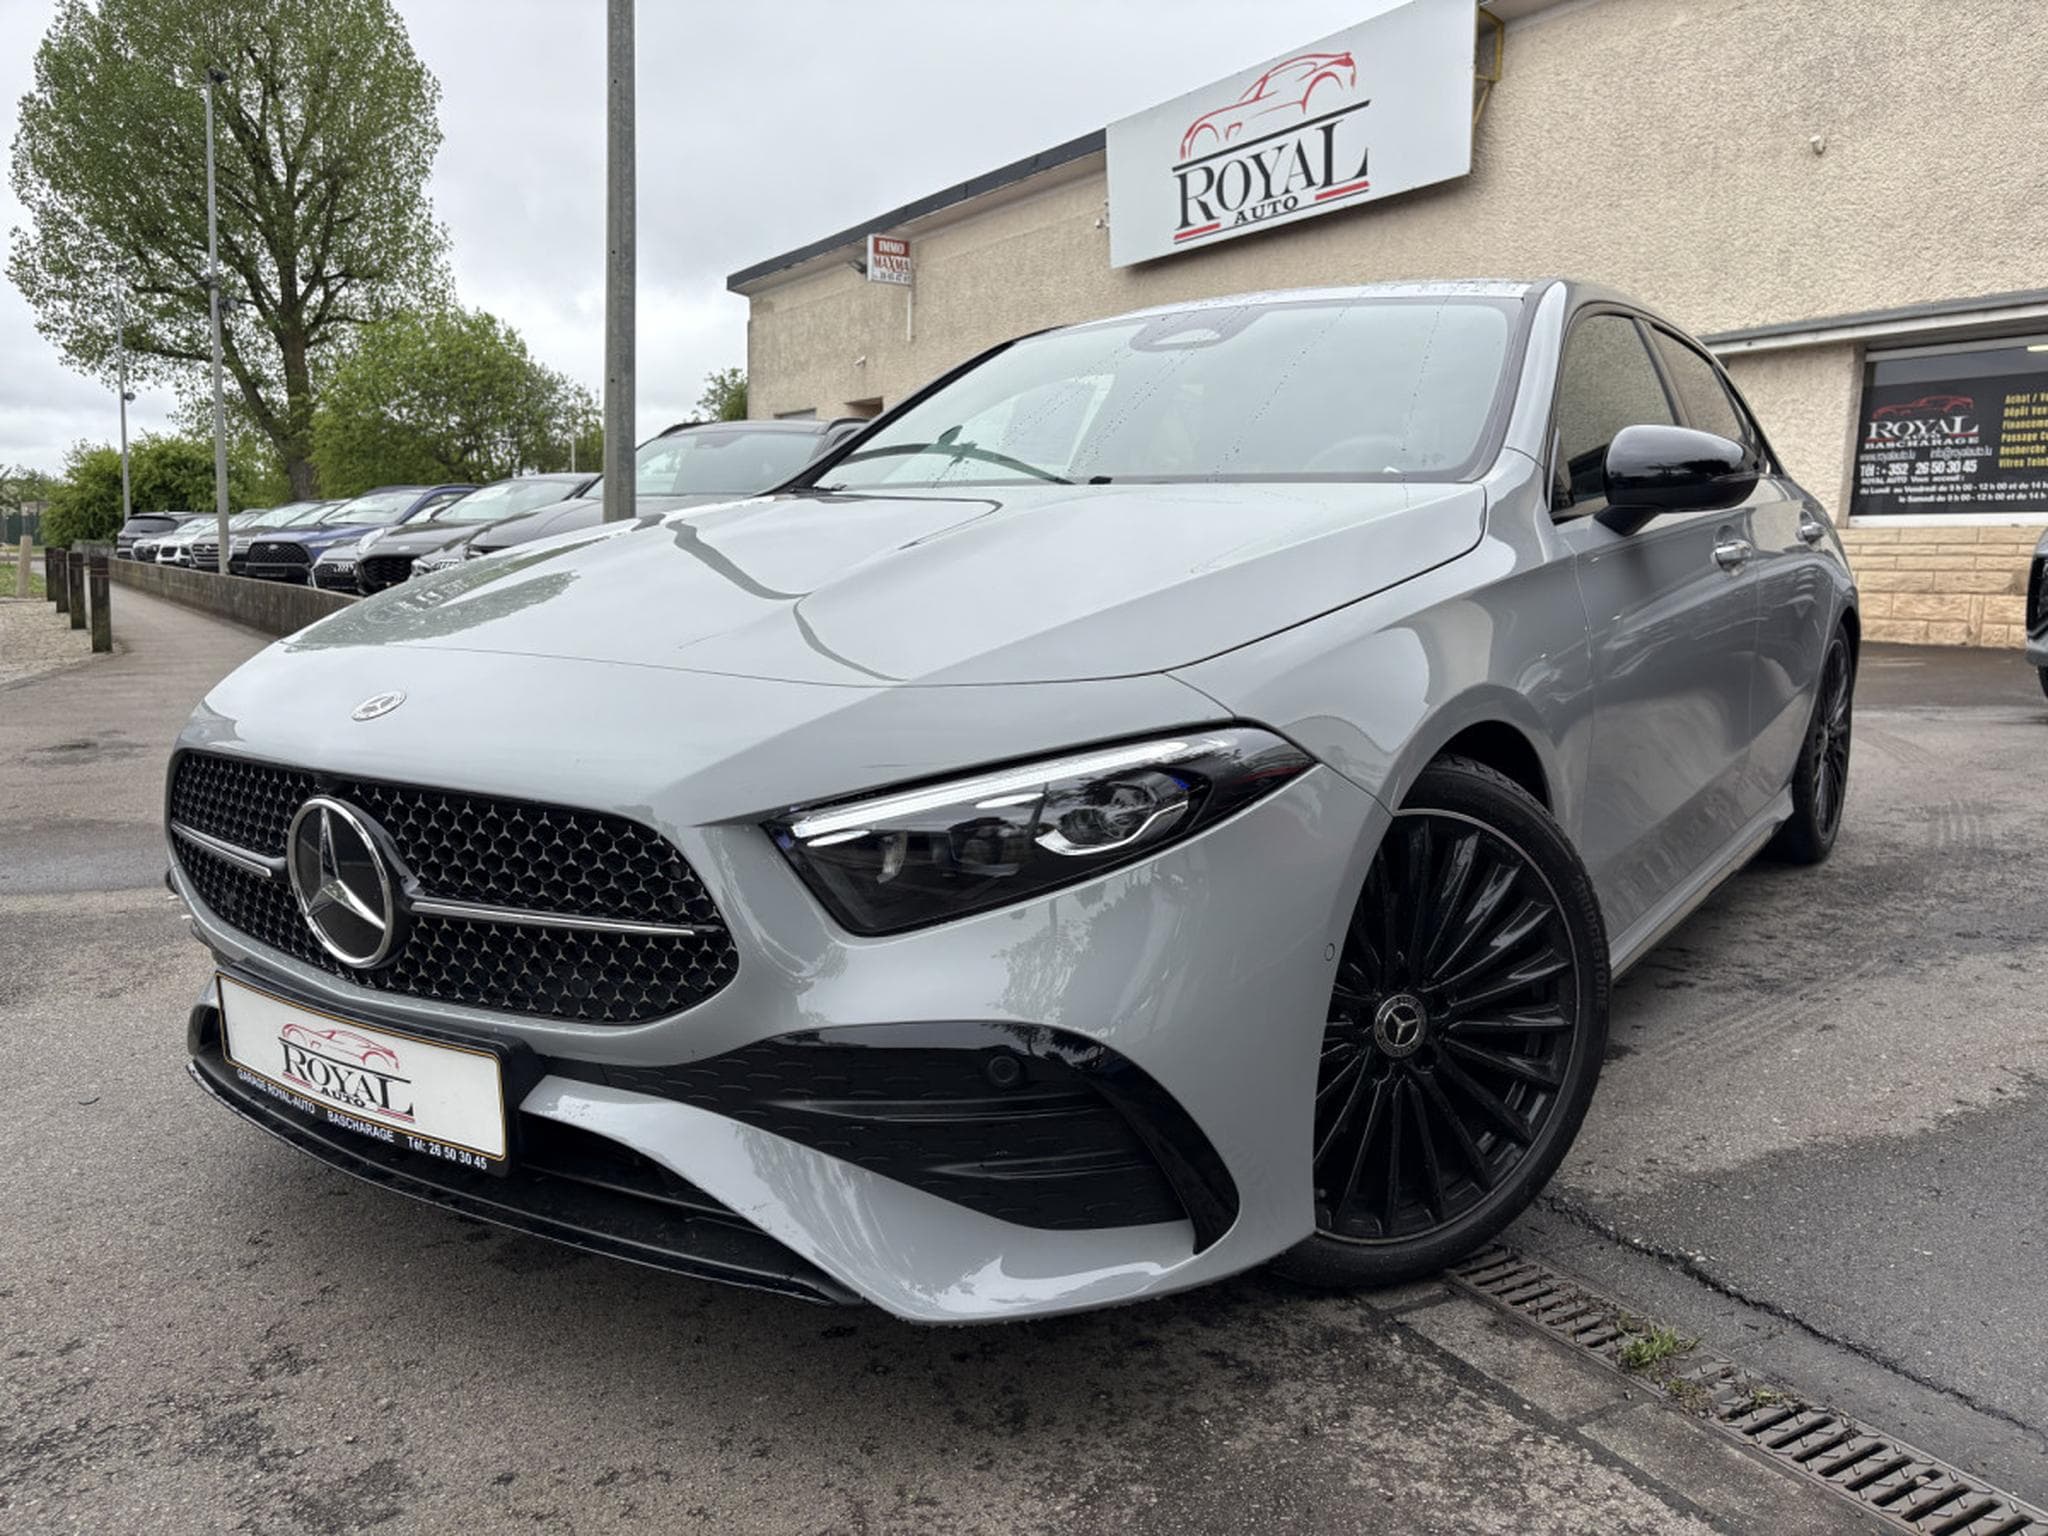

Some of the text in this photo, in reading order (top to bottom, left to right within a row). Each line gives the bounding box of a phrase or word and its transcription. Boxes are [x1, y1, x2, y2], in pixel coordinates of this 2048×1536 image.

[1174, 119, 1369, 231] ROYAL
[1234, 196, 1299, 225] AUTO
[879, 240, 905, 255] IMMO
[2005, 394, 2030, 404] Achat
[1869, 415, 1979, 439] ROYAL
[1865, 437, 1979, 449] BASCHARAGE
[2000, 444, 2047, 456] Recherche
[1914, 462, 1930, 475] 26
[1931, 460, 1946, 474] 50
[1946, 460, 1961, 474] 30
[1962, 459, 1978, 473] 45
[1870, 486, 1890, 494] Lundi
[1904, 484, 1936, 493] Vendredi
[1962, 484, 1974, 492] 00
[1979, 483, 1989, 491] 12
[1990, 482, 1996, 490] h
[1997, 482, 2008, 490] 00
[2019, 482, 2030, 490] de
[2031, 481, 2040, 489] 14
[1886, 476, 1908, 484] AUTO
[1907, 494, 1934, 503] Samedi
[1961, 494, 1972, 502] 00
[1978, 493, 1987, 501] 12
[1995, 492, 2006, 500] 00
[2017, 492, 2028, 500] de
[2029, 491, 2038, 500] 14
[280, 1042, 415, 1116] ROYAL
[321, 1087, 366, 1108] AUTO
[327, 1110, 395, 1143] BASCHARAGE
[429, 1142, 442, 1157] 26
[445, 1146, 457, 1161] 50
[459, 1150, 472, 1165] 30
[474, 1155, 488, 1170] 45
